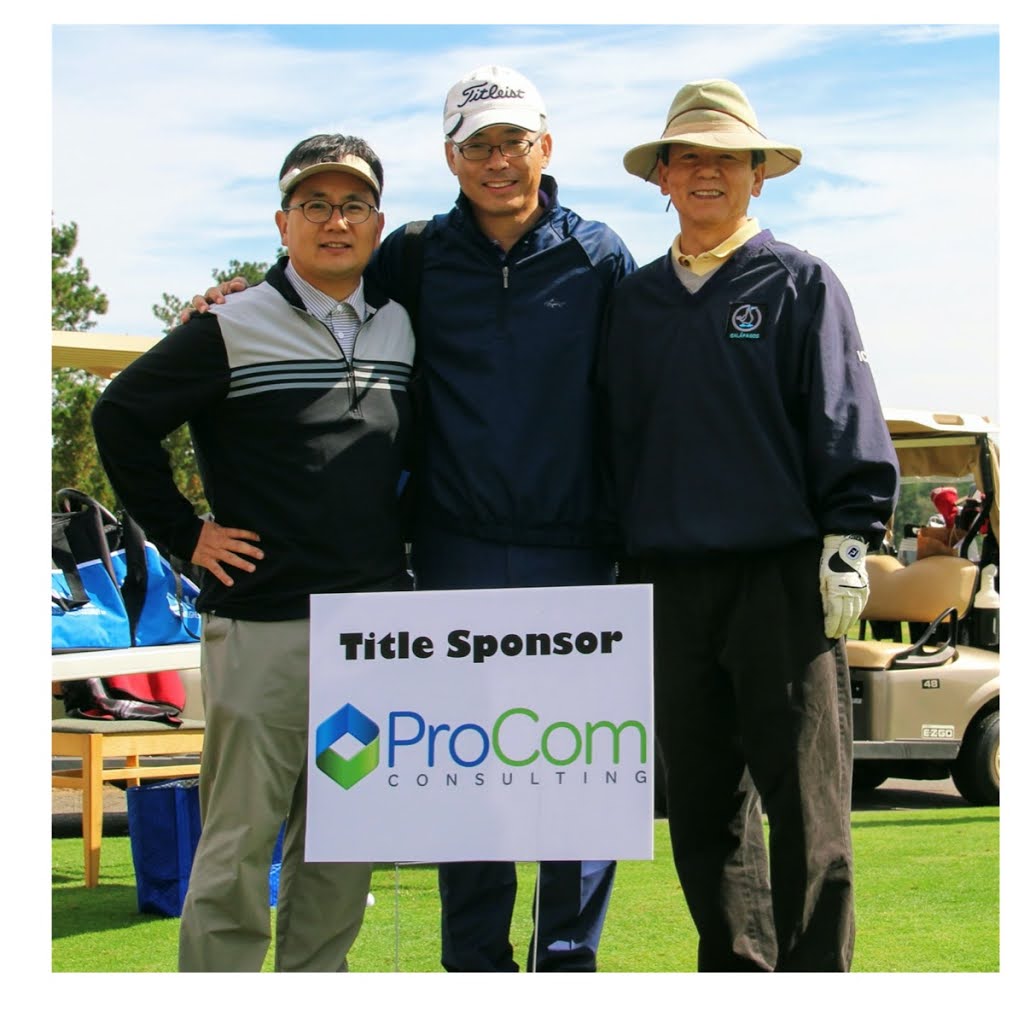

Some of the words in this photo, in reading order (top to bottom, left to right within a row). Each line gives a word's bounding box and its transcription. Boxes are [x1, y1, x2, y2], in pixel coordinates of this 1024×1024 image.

[457, 81, 526, 108] Titleist
[340, 631, 434, 660] Title
[447, 629, 623, 663] Sponsor
[923, 679, 938, 688] 48
[388, 707, 647, 768] ProCom
[388, 771, 648, 788] CONSULTING
